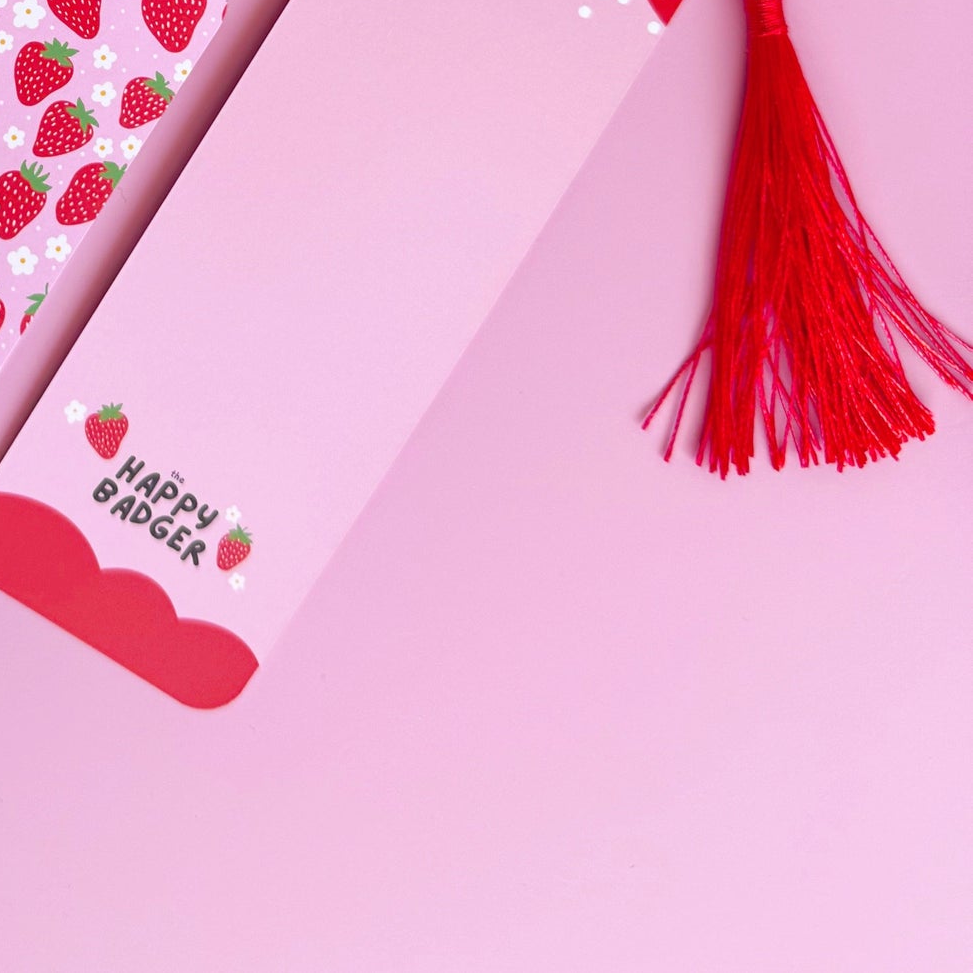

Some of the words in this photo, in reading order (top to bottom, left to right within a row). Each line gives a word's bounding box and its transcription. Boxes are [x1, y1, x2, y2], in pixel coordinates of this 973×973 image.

[115, 455, 219, 530] HAPPY
[170, 469, 185, 484] the
[92, 477, 206, 566] BADGER
